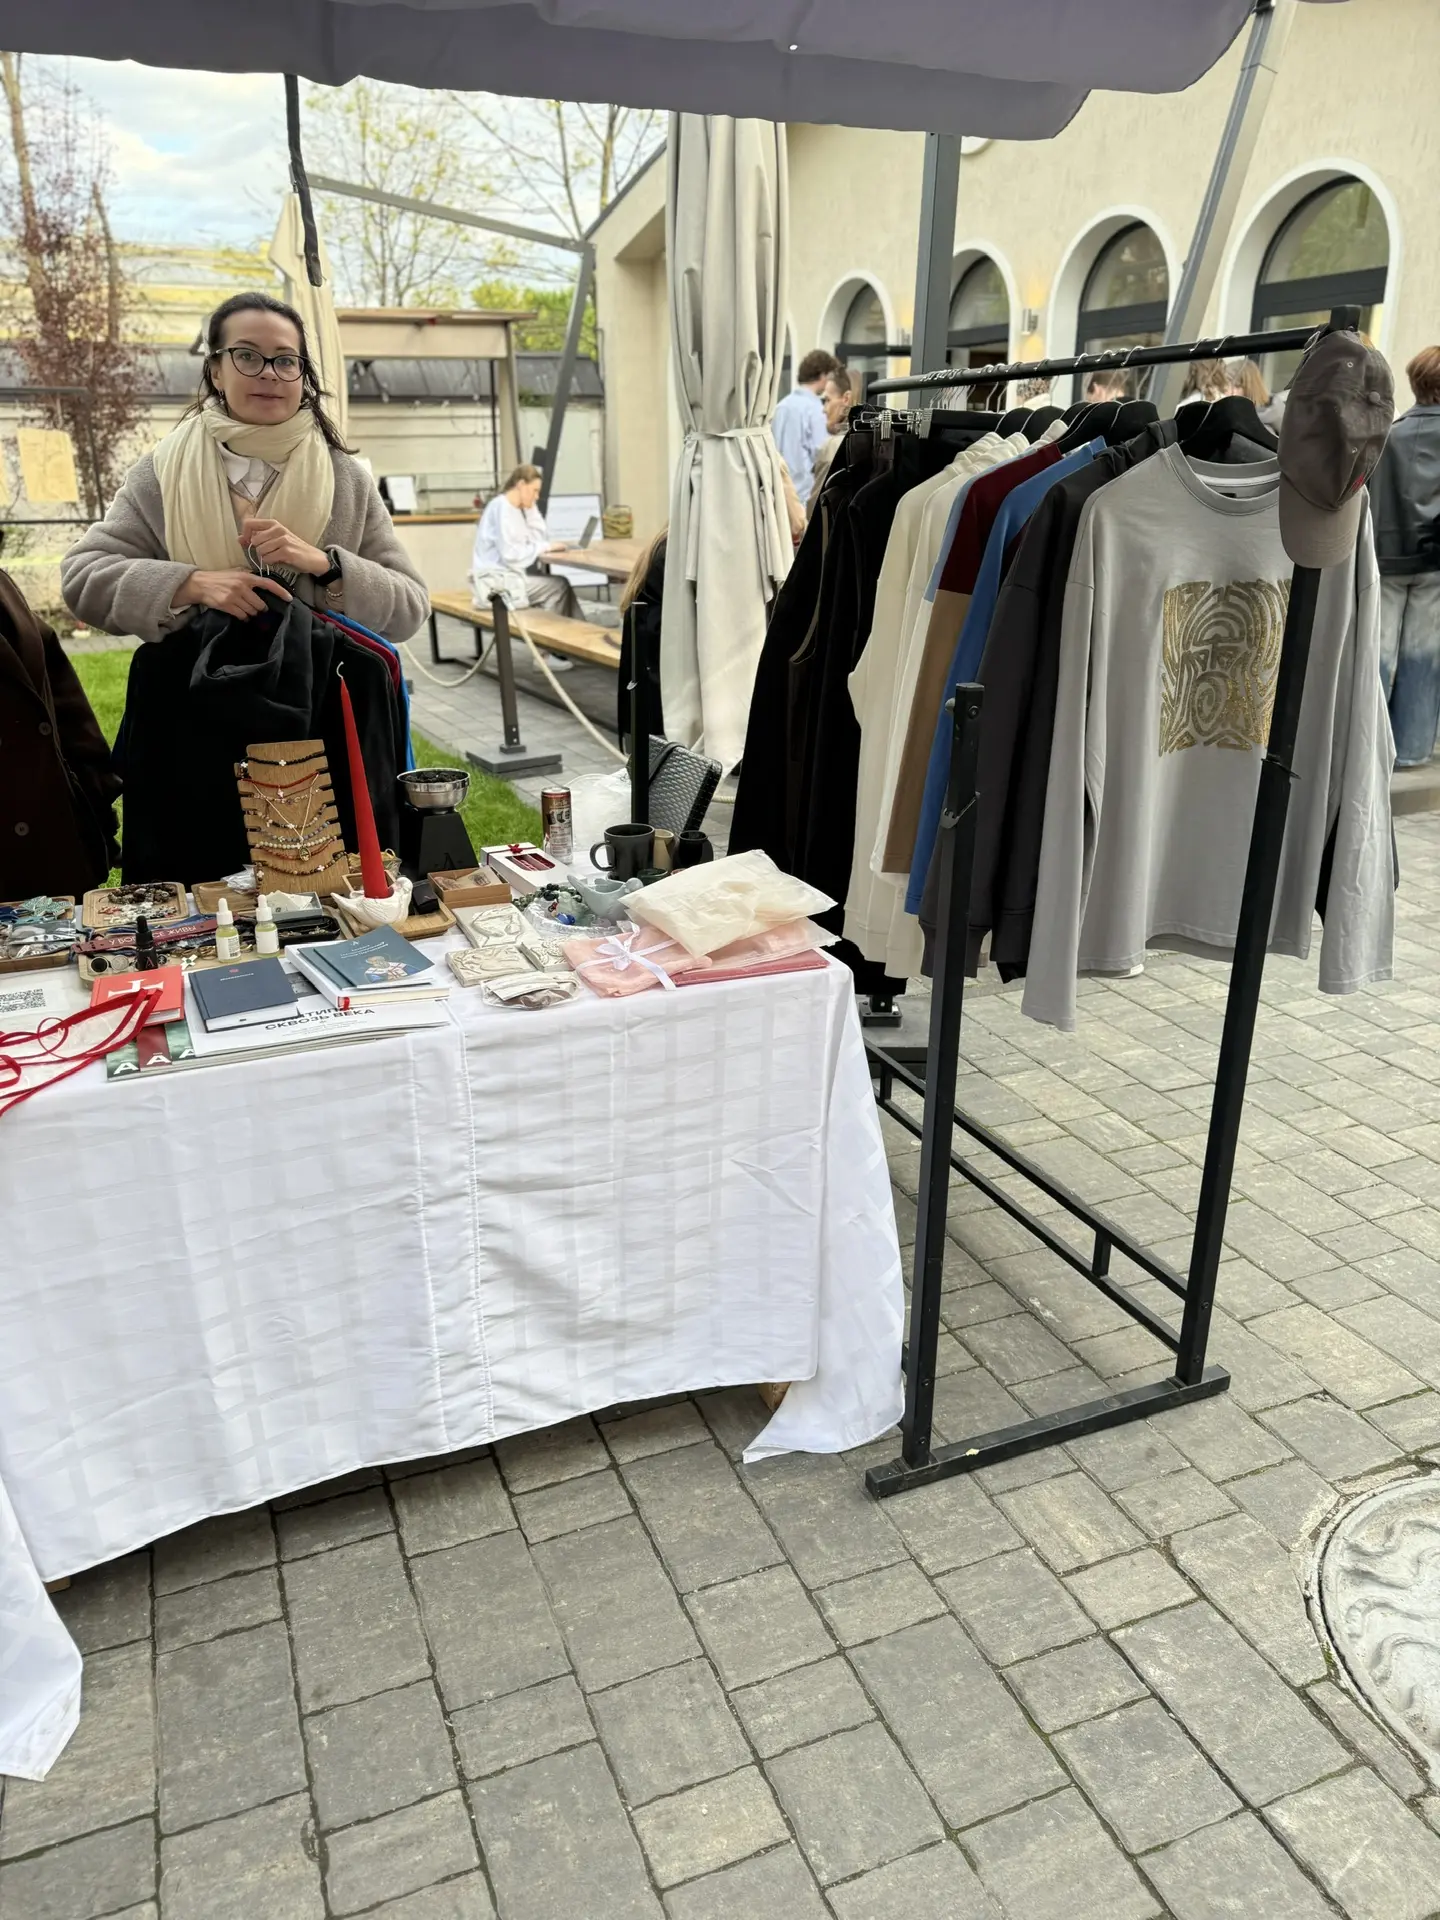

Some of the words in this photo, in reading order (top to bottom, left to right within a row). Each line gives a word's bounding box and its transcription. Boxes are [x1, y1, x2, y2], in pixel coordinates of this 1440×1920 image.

[168, 925, 197, 935] ЖИВЫ
[264, 1015, 330, 1030] СКВОЗЬ
[333, 1008, 375, 1018] ВЕКА
